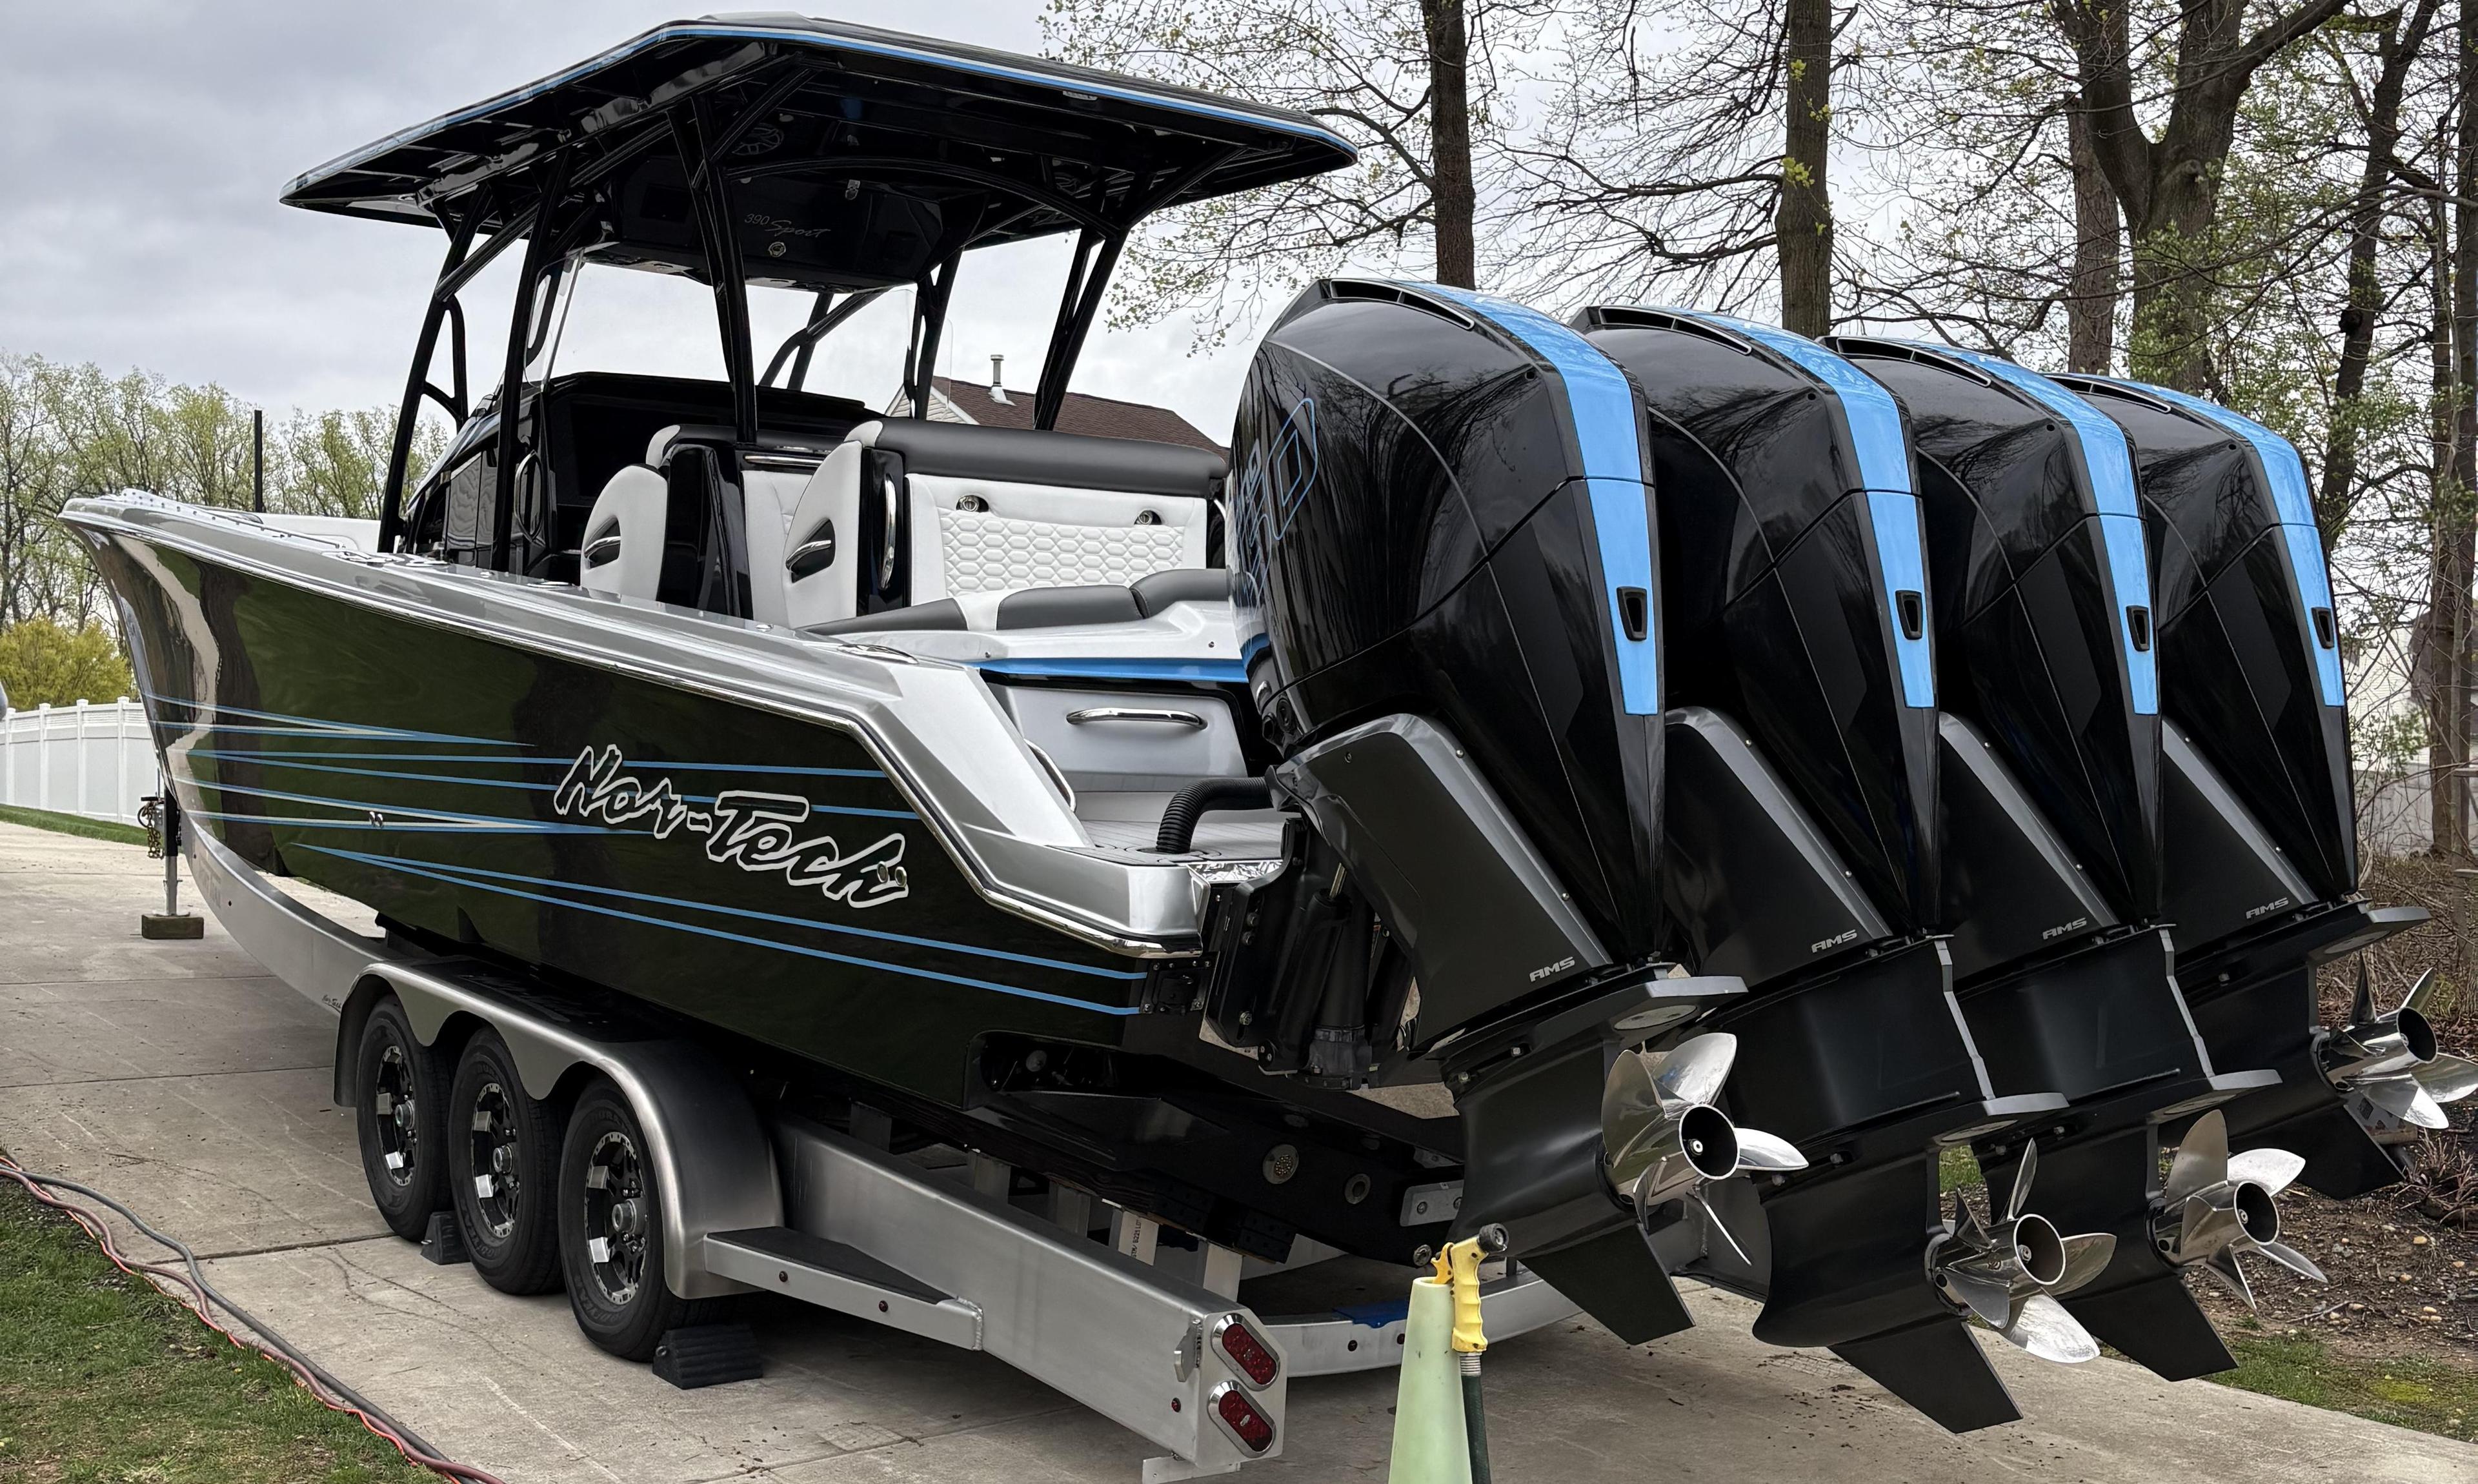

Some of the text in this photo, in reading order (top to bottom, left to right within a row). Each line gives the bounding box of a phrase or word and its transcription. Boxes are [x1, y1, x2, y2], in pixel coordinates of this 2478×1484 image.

[744, 213, 831, 237] 390 Sport
[554, 744, 909, 908] Nor-Tech
[2246, 897, 2289, 919] AMS
[2042, 917, 2087, 940] AMS
[1811, 929, 1857, 953] AMS
[1529, 956, 1575, 982] AMS
